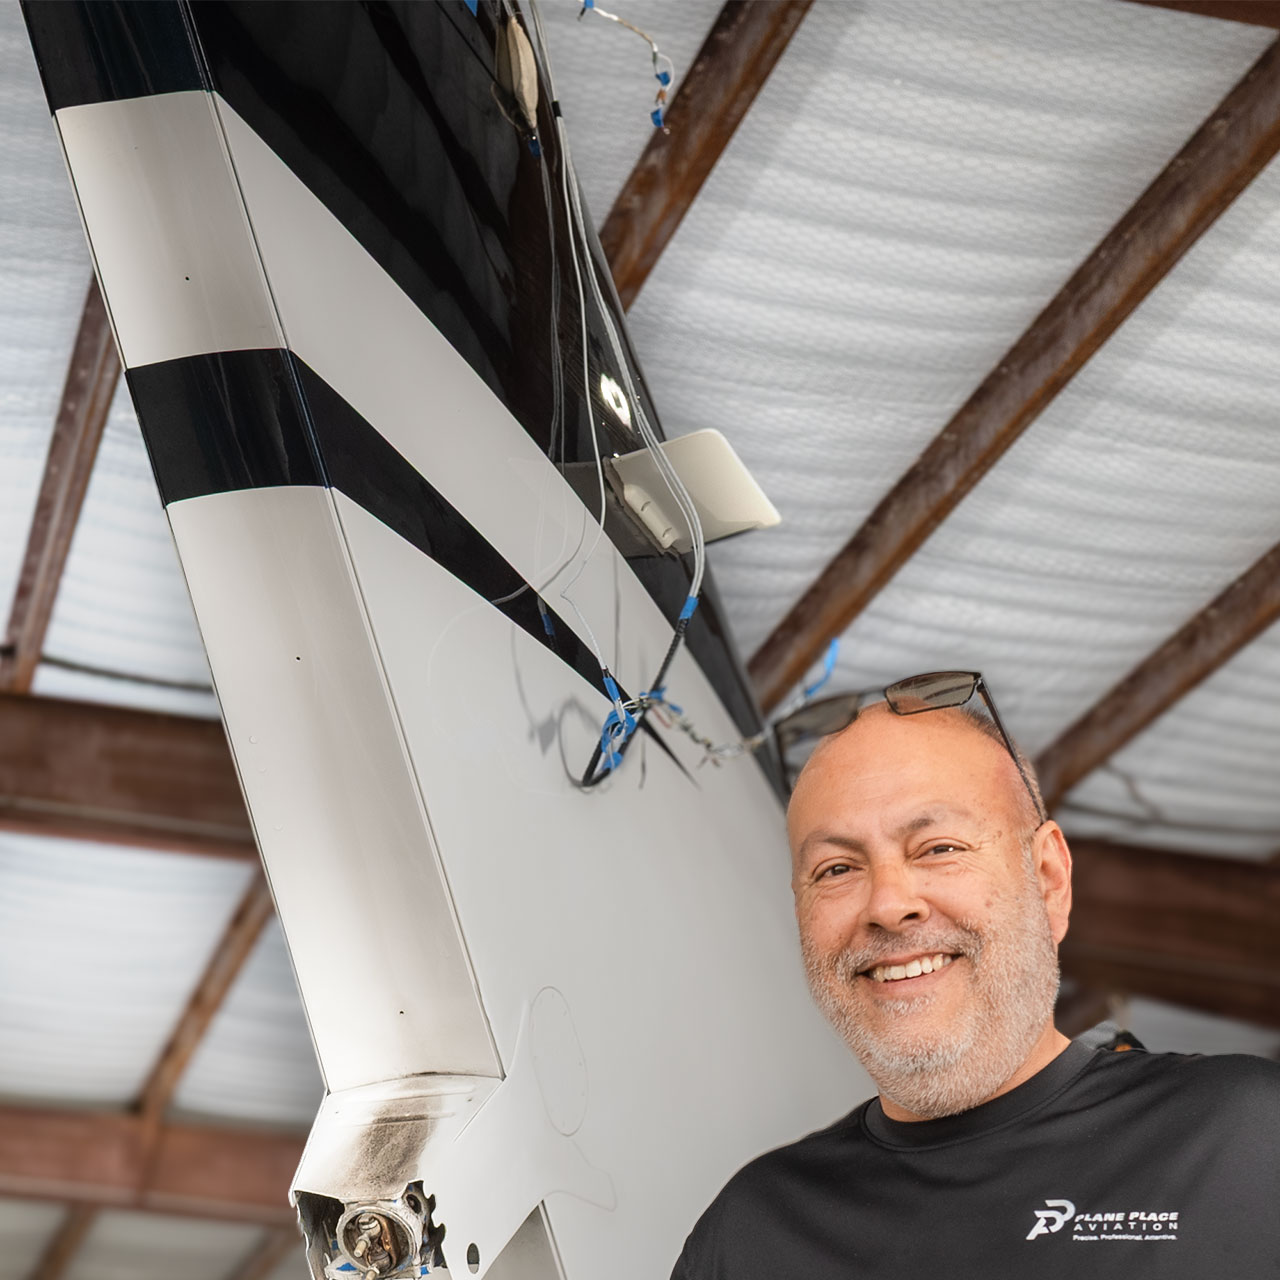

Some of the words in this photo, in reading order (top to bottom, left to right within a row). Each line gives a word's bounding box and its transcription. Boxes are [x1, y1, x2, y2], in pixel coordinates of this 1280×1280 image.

[1074, 1213, 1126, 1223] PLANE
[1128, 1212, 1179, 1221] PLACE
[1073, 1222, 1178, 1231] AVIATION
